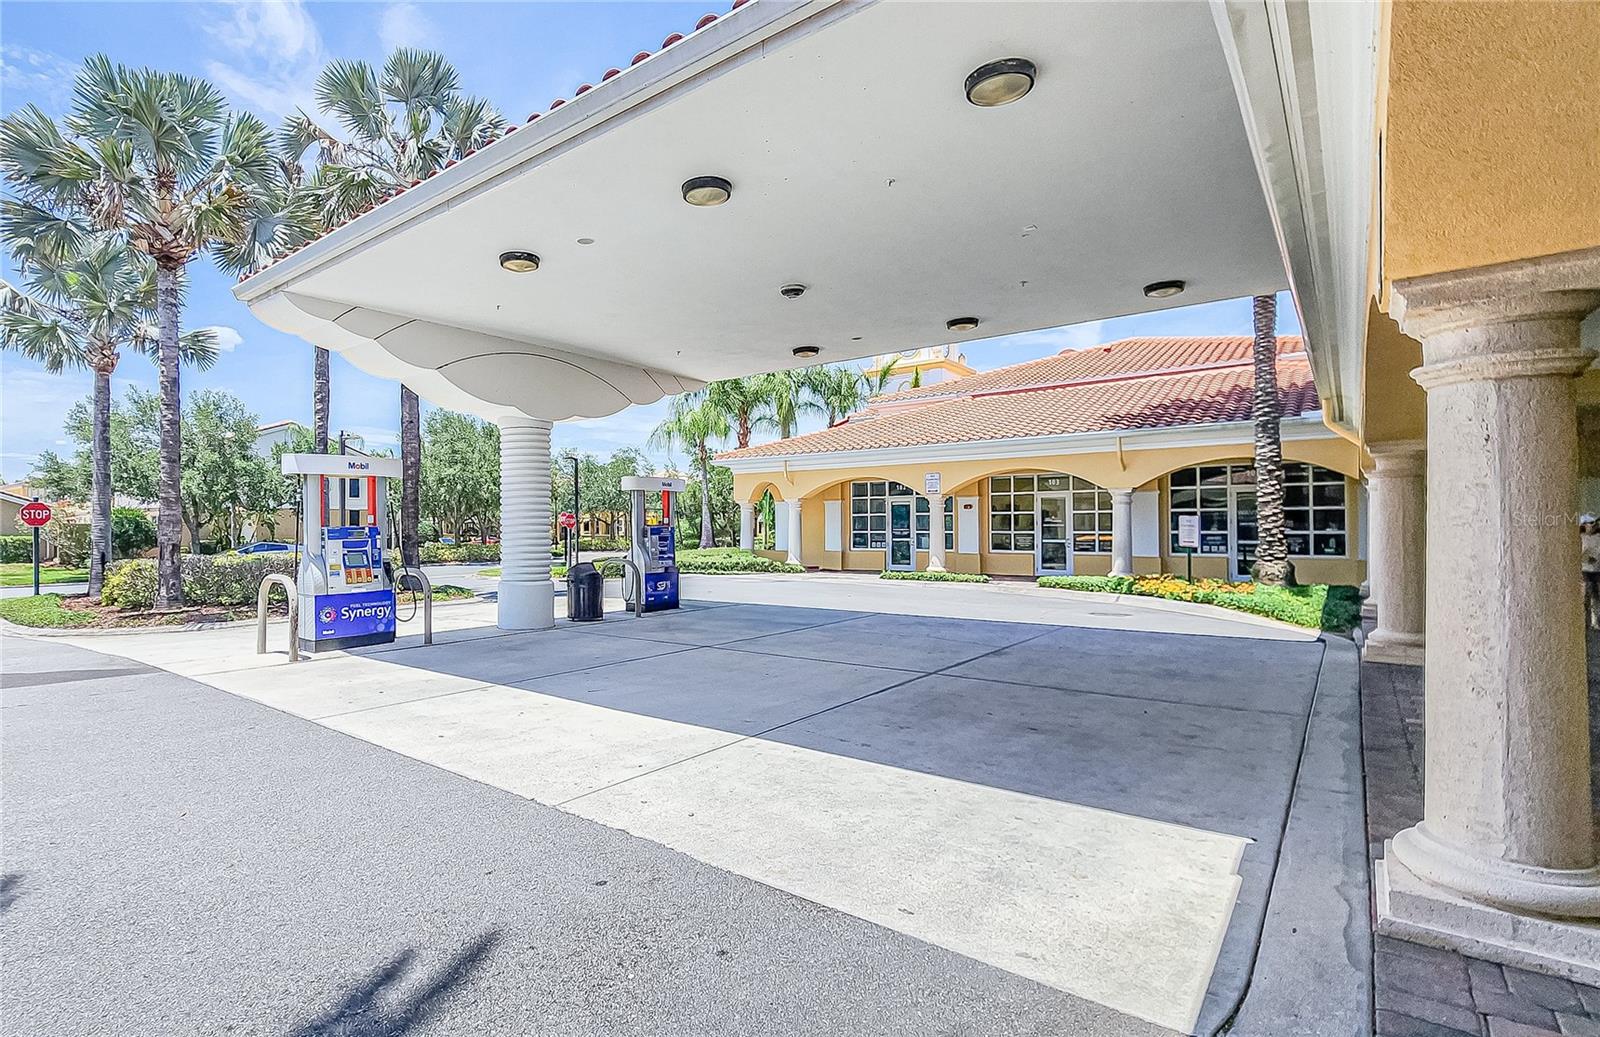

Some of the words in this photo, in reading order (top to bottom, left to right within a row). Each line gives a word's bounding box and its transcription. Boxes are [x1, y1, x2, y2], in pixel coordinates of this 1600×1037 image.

[348, 462, 370, 470] Mobil
[22, 509, 50, 519] STOP
[341, 606, 392, 622] Synergy
